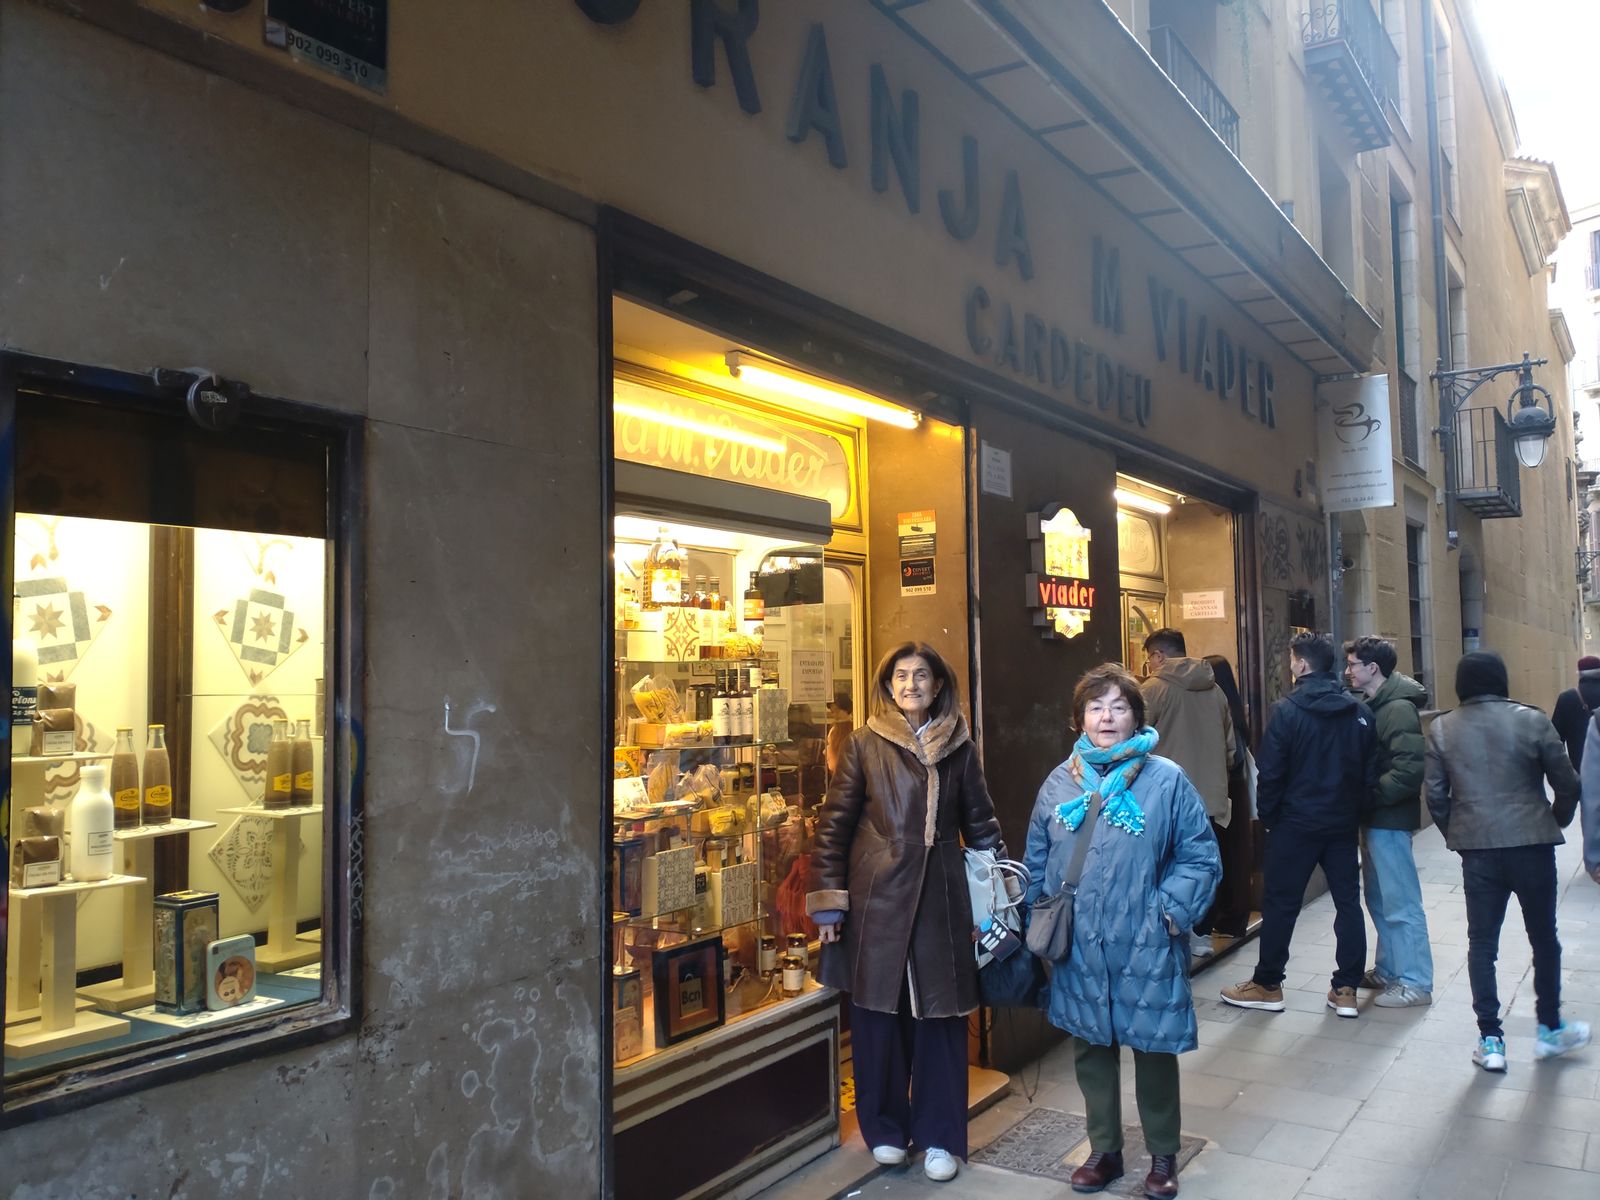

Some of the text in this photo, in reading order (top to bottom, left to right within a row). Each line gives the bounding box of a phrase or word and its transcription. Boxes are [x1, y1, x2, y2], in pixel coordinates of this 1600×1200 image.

[287, 32, 368, 78] 902 099 510
[573, 0, 1276, 430] RANJA M VIADER
[965, 285, 1152, 428] CARDEDEU
[703, 412, 828, 488] Viader
[1040, 578, 1096, 607] viader
